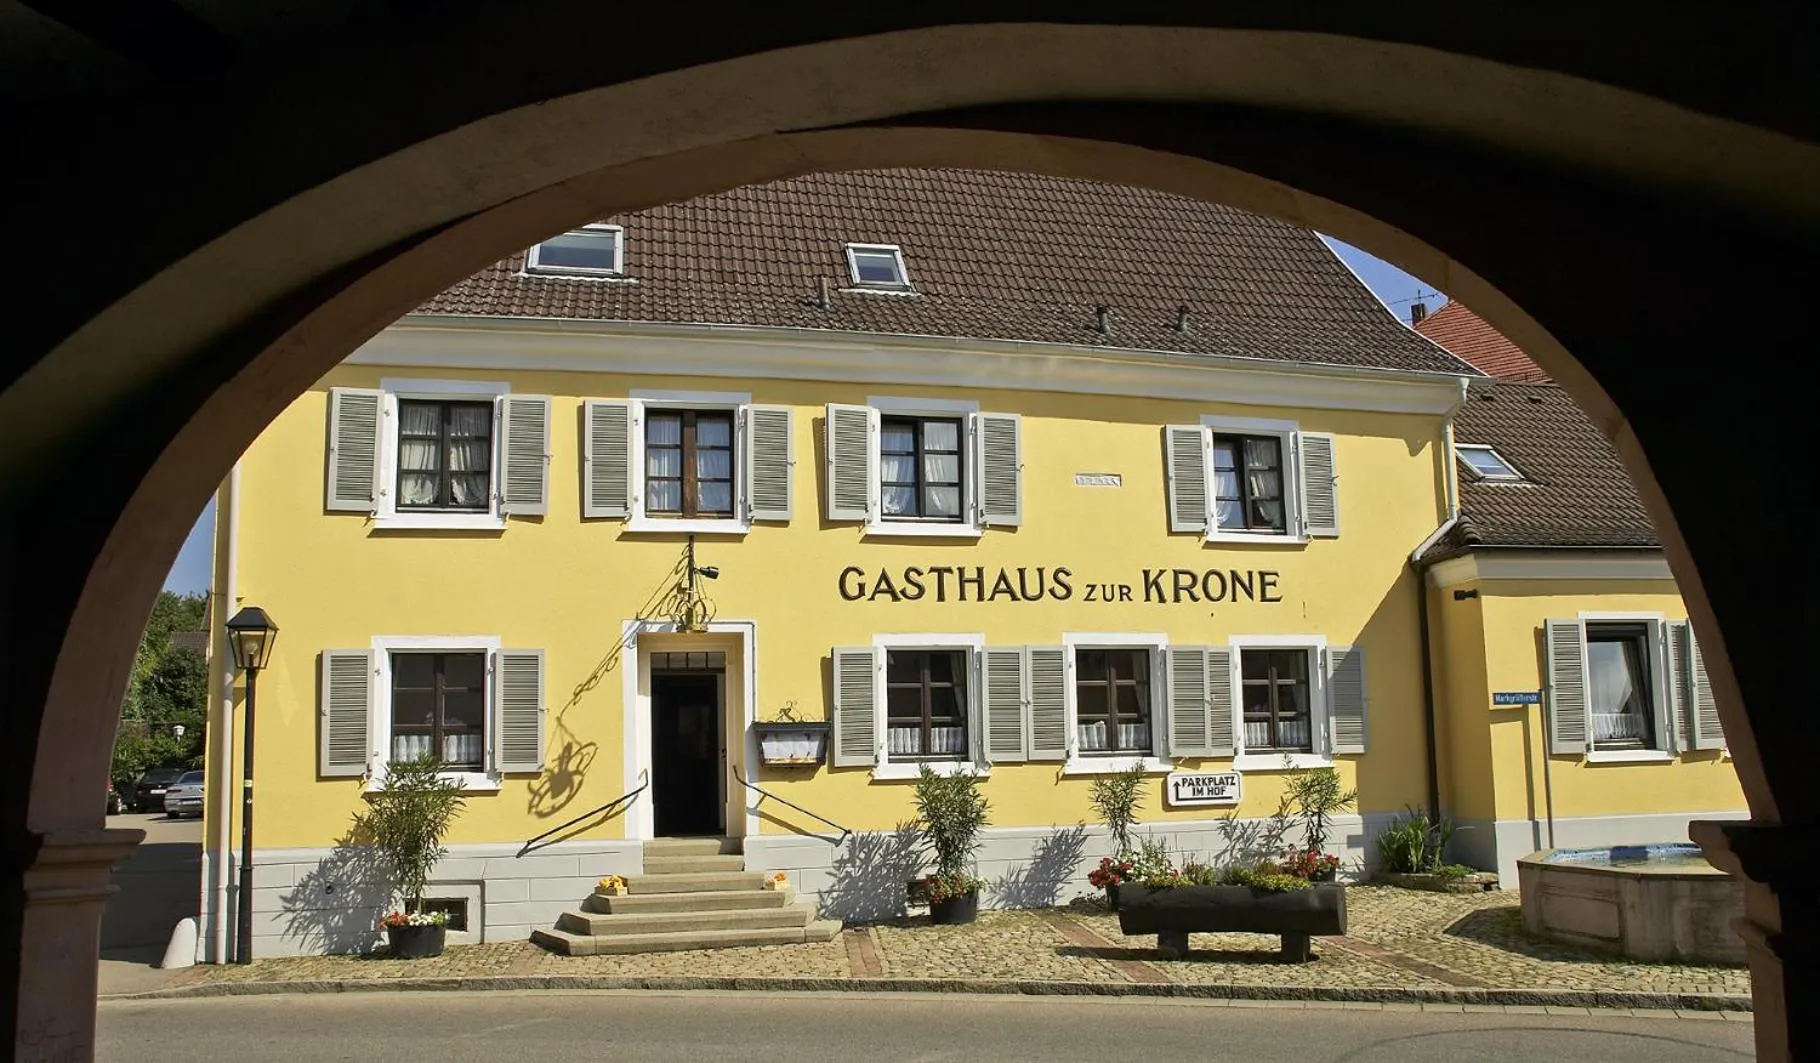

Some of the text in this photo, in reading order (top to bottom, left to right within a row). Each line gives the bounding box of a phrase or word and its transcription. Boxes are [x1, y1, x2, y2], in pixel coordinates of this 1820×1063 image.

[838, 566, 1283, 604] GASTHAUS ZUR KRONE
[1181, 776, 1236, 788] PARKPLATZ
[1192, 786, 1227, 797] IM HOF
